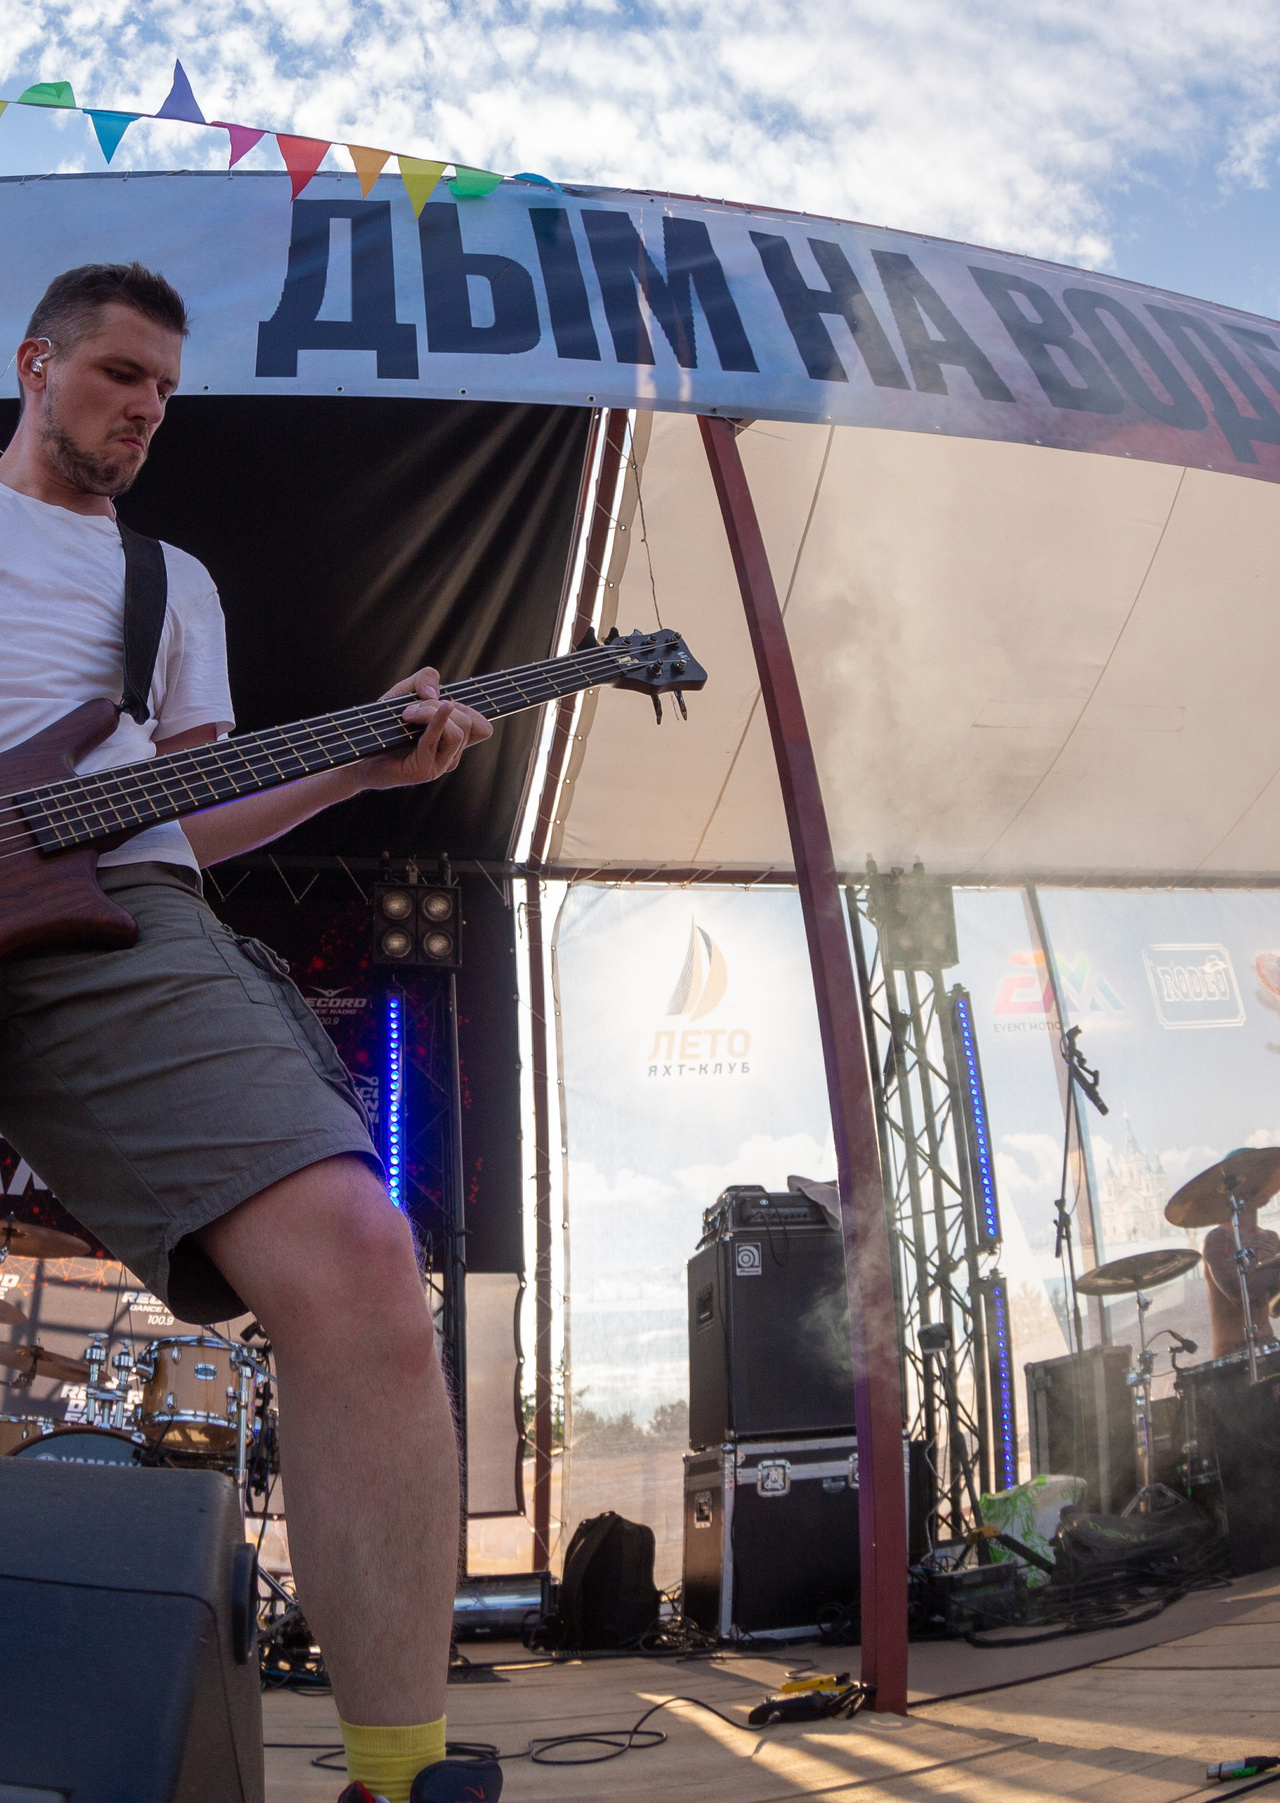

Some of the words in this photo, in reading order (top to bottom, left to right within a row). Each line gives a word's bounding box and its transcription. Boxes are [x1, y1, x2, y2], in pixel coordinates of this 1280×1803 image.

[255, 198, 759, 380] ДЫМ
[748, 229, 1017, 404] НА
[966, 264, 1280, 465] ВОД
[305, 997, 368, 1009] ECORD
[993, 1022, 1027, 1033] EVENT
[1029, 1021, 1063, 1032] MOTIO
[647, 1028, 751, 1062] ЛЕТО
[648, 1062, 751, 1077] ЯХТ-КЛУБ
[130, 1304, 163, 1313] DANCE
[147, 1314, 175, 1326] 100.9
